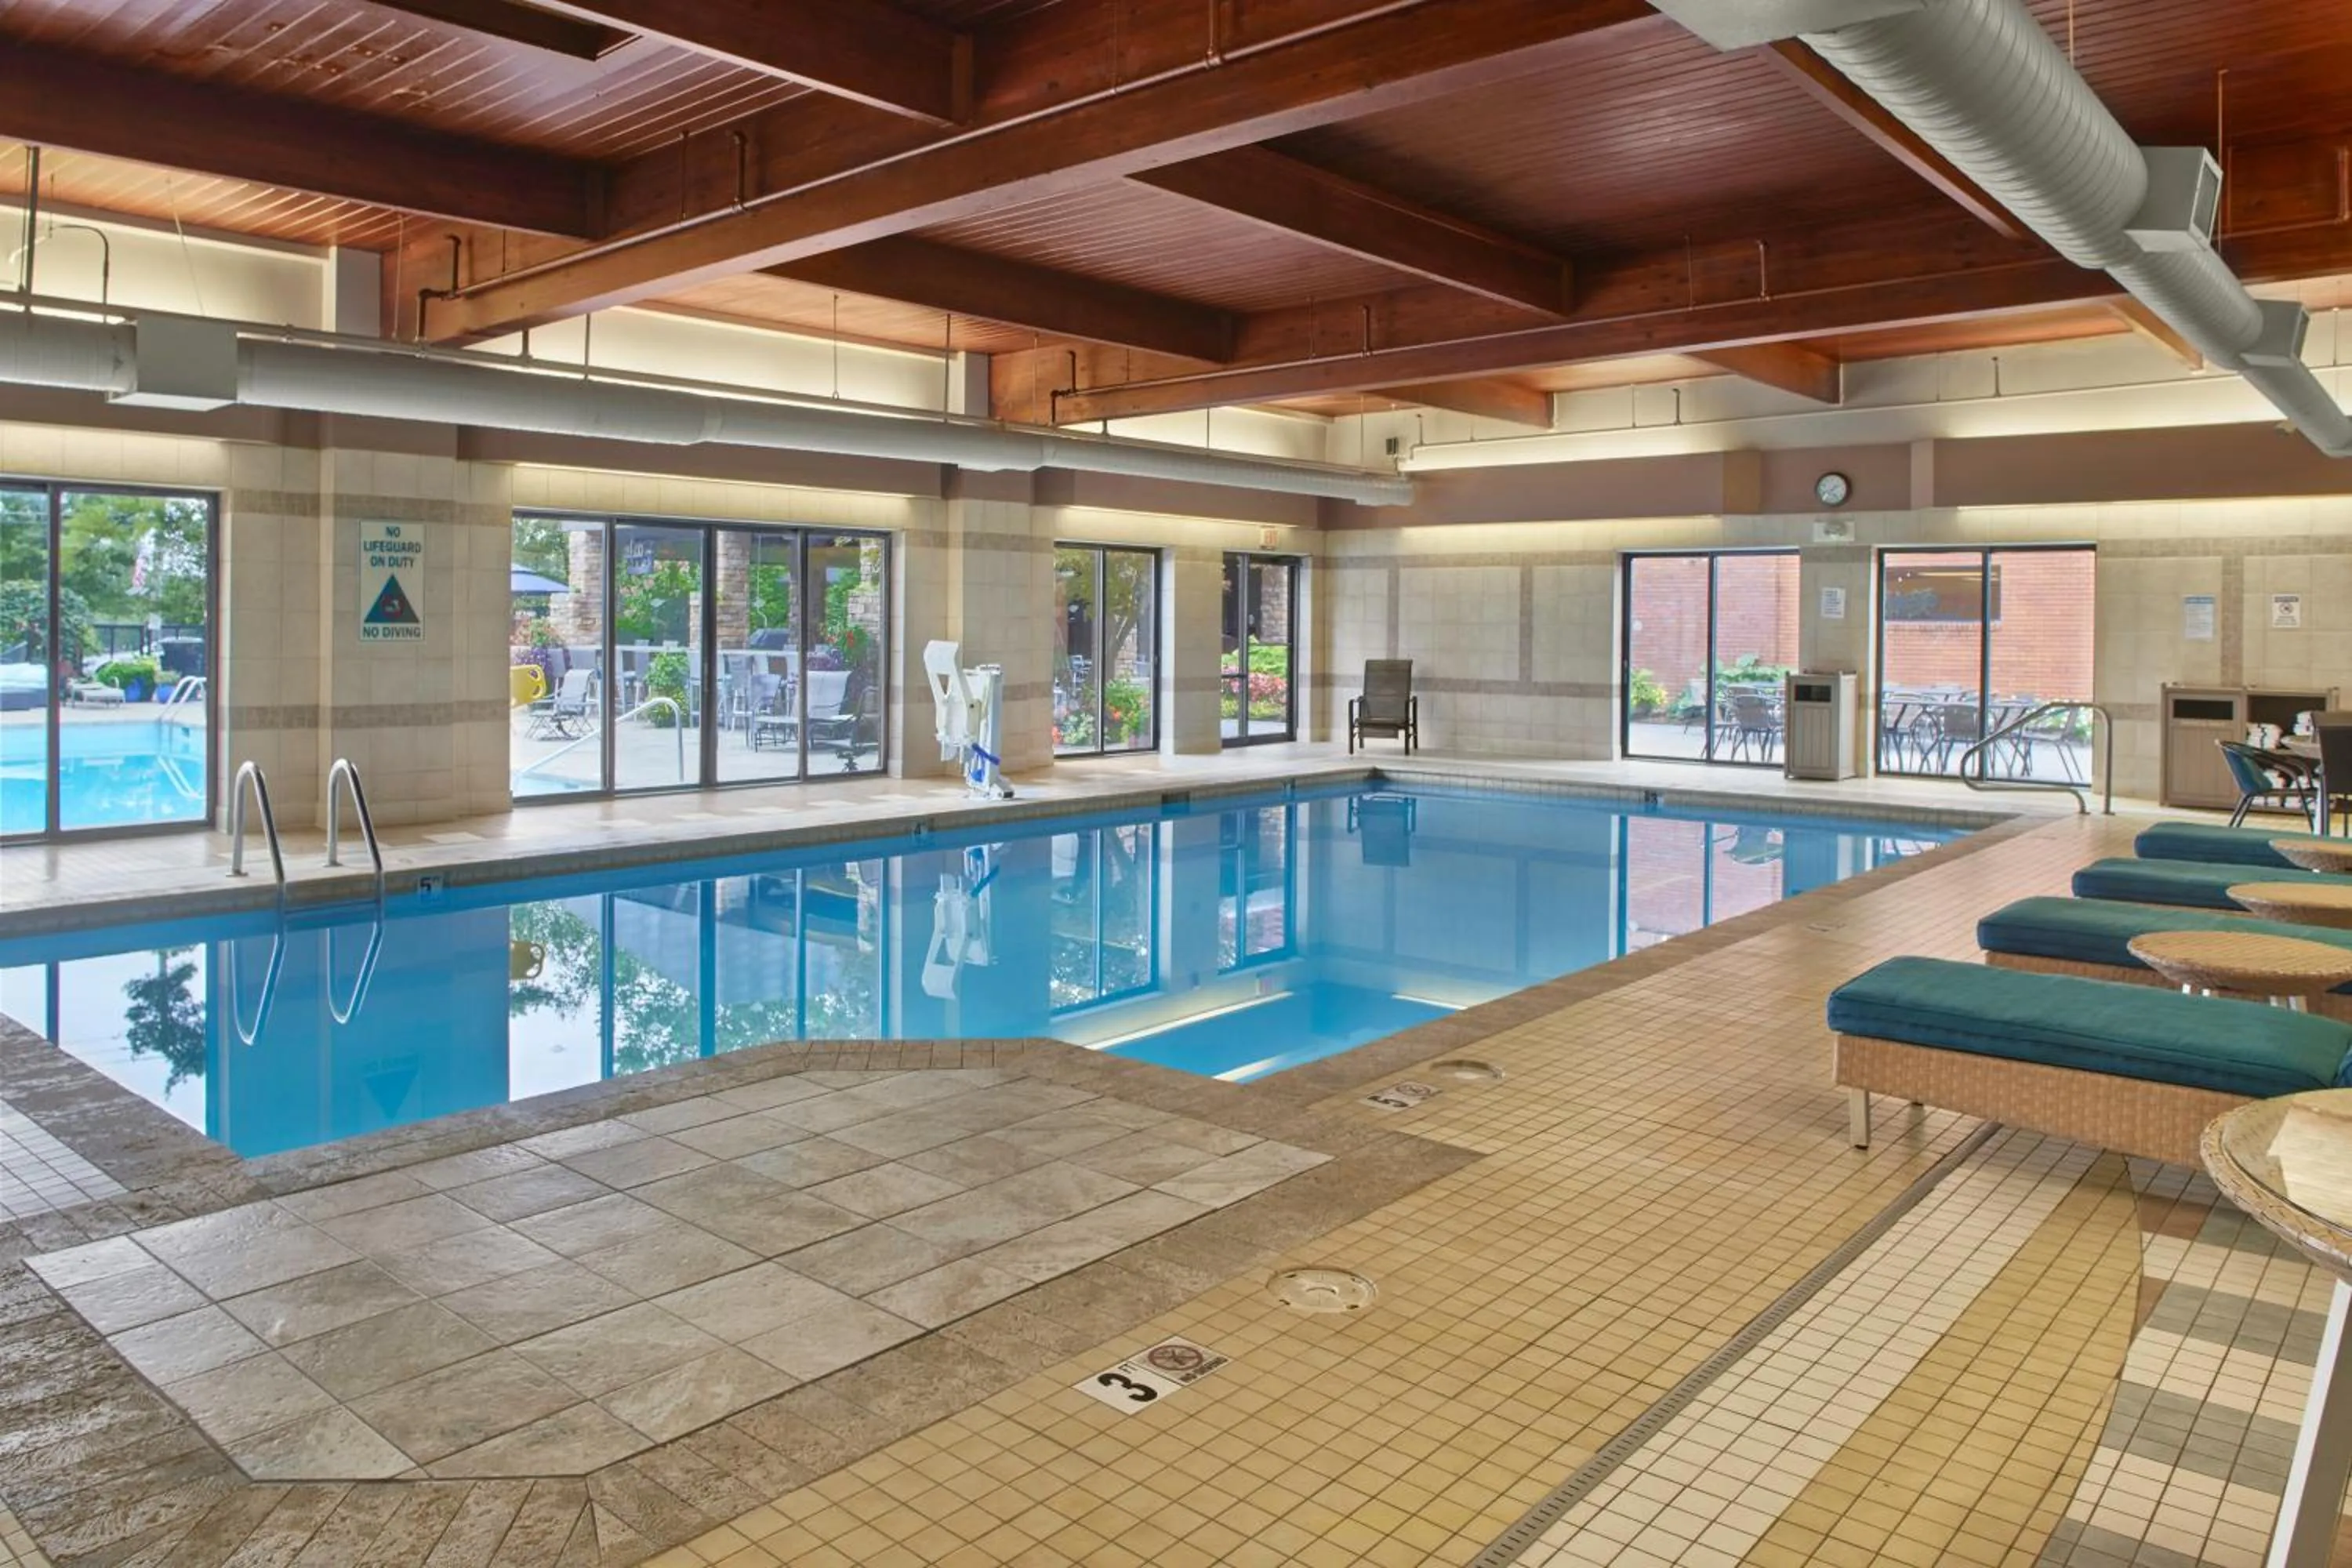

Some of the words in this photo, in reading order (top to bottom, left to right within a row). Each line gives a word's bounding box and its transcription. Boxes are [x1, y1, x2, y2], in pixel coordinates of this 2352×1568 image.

[386, 527, 401, 537] NO
[364, 541, 421, 553] LIFEGUARD
[371, 556, 385, 567] ON
[389, 556, 415, 568] DUTY
[363, 627, 379, 637] NO
[383, 627, 421, 638] DIVING
[1098, 1373, 1158, 1402] 3
